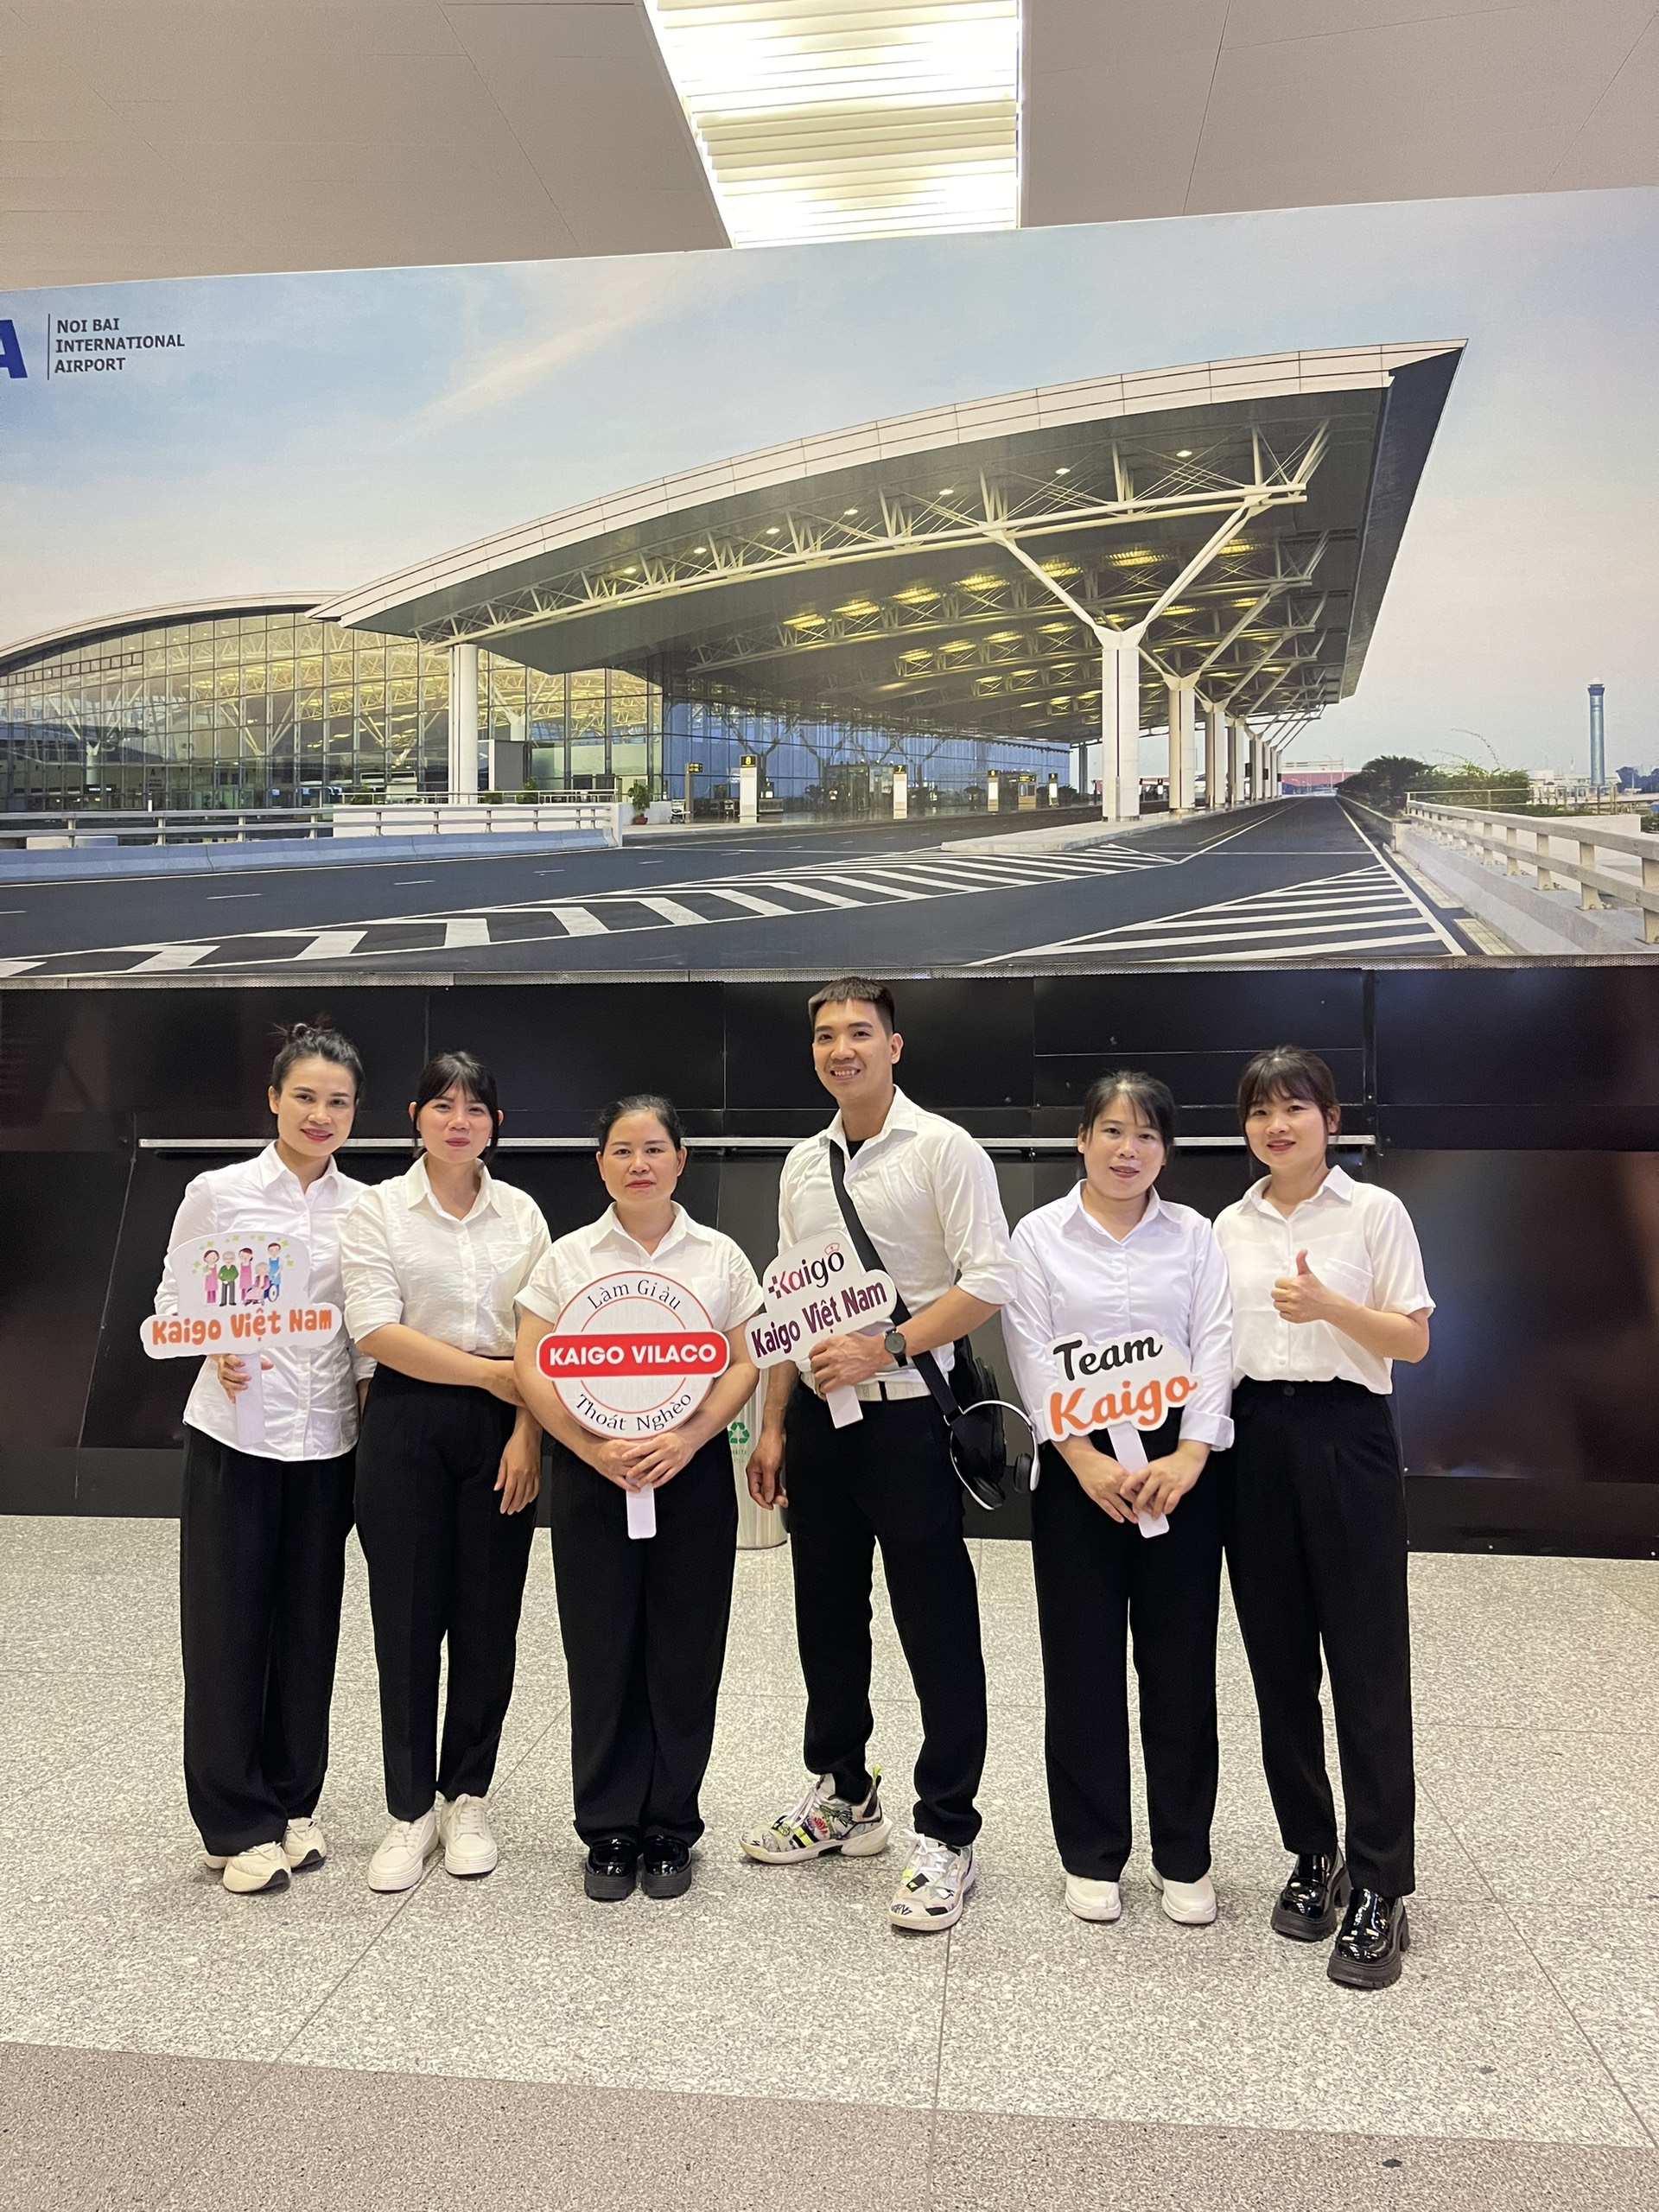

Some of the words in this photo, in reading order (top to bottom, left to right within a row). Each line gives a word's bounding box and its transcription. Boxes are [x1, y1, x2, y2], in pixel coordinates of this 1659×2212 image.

[57, 319, 88, 334] NOI
[92, 317, 120, 332] BAI
[55, 334, 185, 353] INTERNATIONAL
[54, 357, 126, 373] AIRPORT
[745, 756, 752, 766] 8
[587, 1282, 630, 1310] Làm
[152, 1318, 221, 1345] Kaigo
[230, 1307, 281, 1342] Việt
[289, 1309, 332, 1333] Nam
[750, 1320, 801, 1358] Kaigo
[802, 1296, 842, 1334] Việt
[841, 1282, 887, 1319] Nam
[550, 1345, 625, 1366] KAIGO
[631, 1344, 716, 1363] VILACO
[1052, 1336, 1163, 1382] Team
[575, 1394, 626, 1431] Thoát
[636, 1394, 691, 1431] Nghèo
[1050, 1376, 1198, 1436] Kaigo
